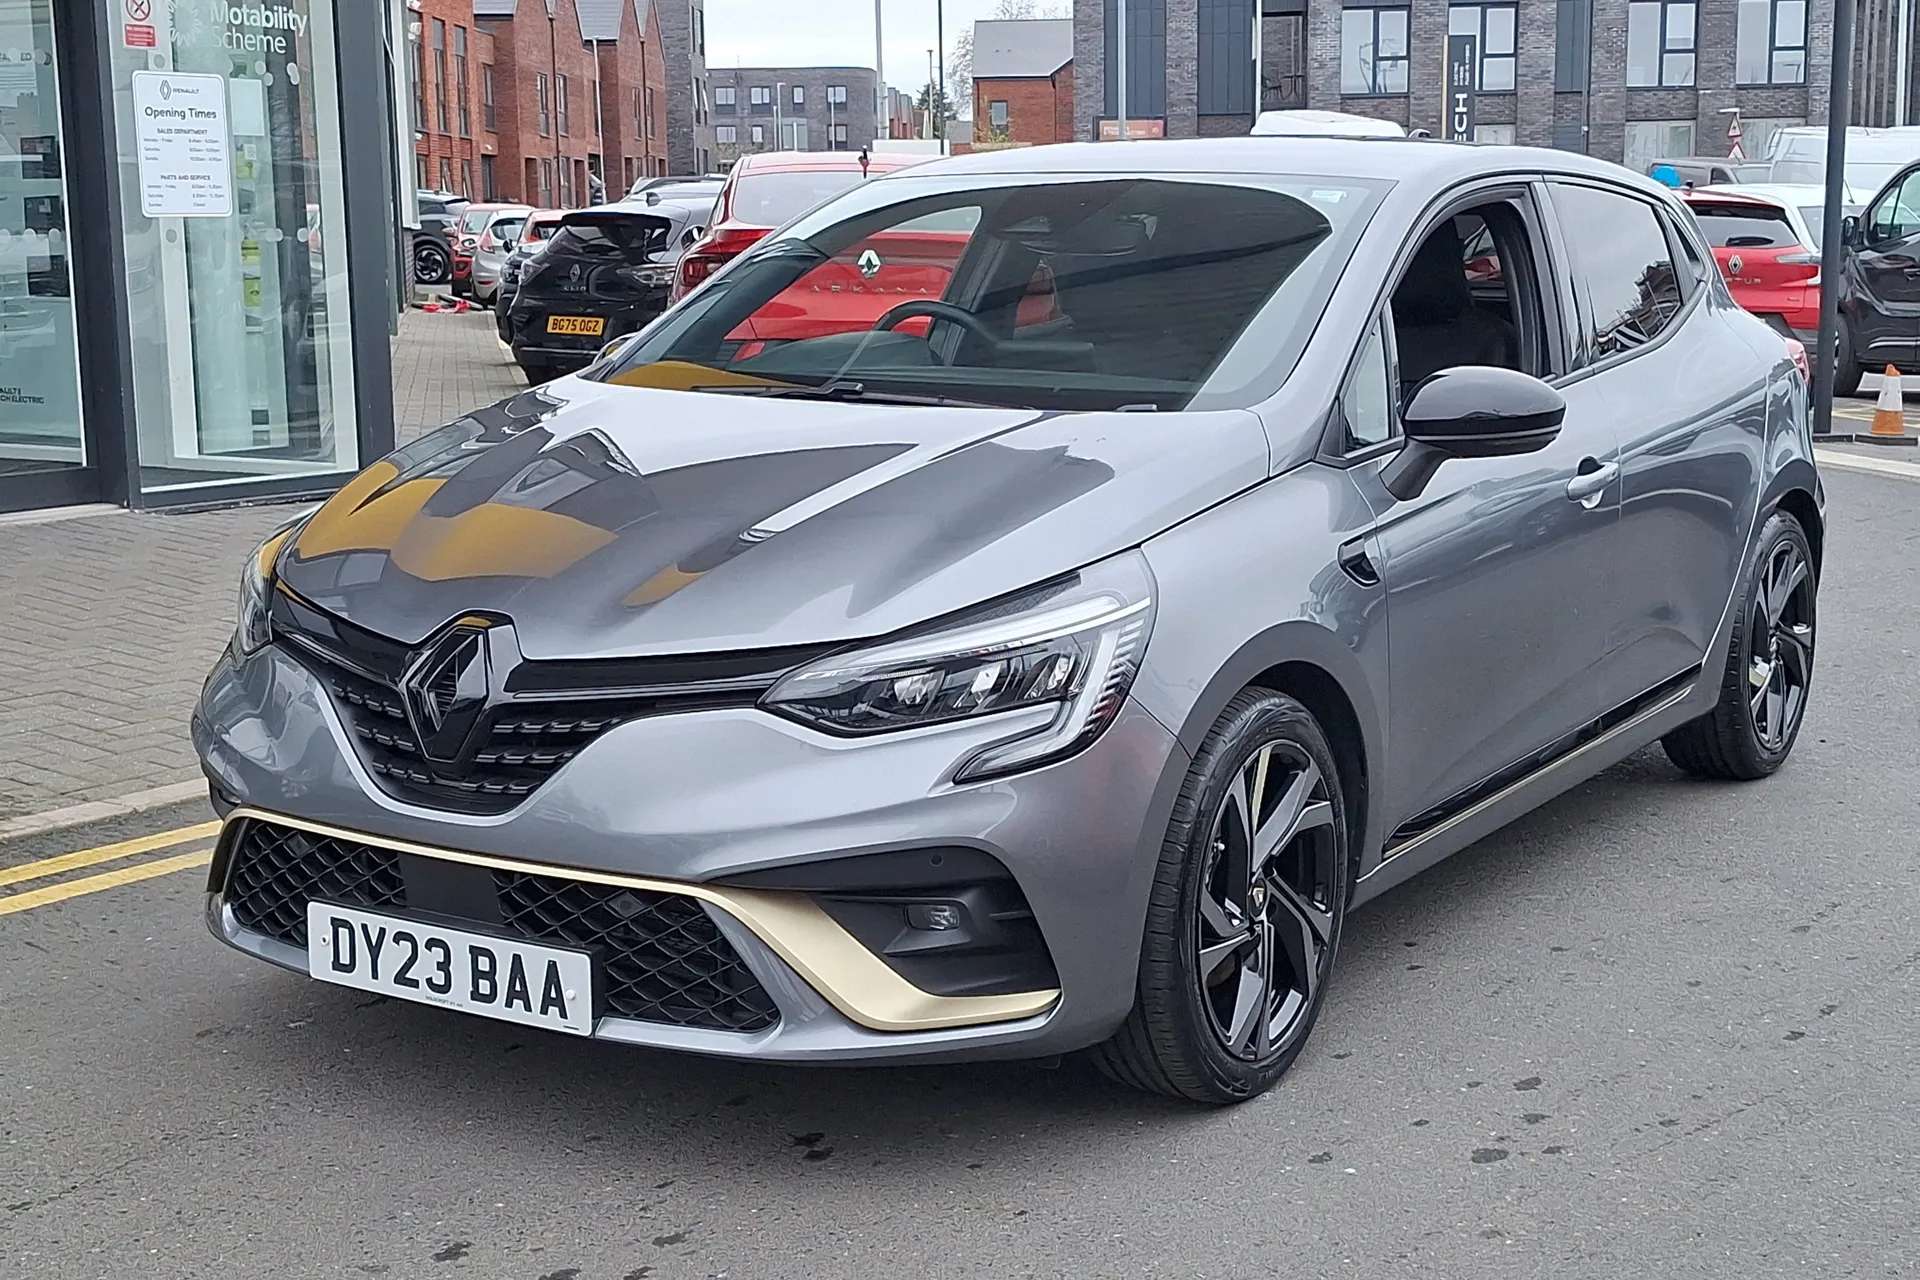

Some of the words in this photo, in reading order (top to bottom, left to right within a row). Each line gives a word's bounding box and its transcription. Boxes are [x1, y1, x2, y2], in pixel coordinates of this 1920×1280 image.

[210, 0, 307, 37] Motability
[209, 26, 287, 54] Scheme
[144, 106, 186, 120] Opening
[188, 107, 217, 119] Times
[551, 318, 578, 332] BG75
[329, 915, 453, 996] DY23
[467, 943, 570, 1021] BAA
